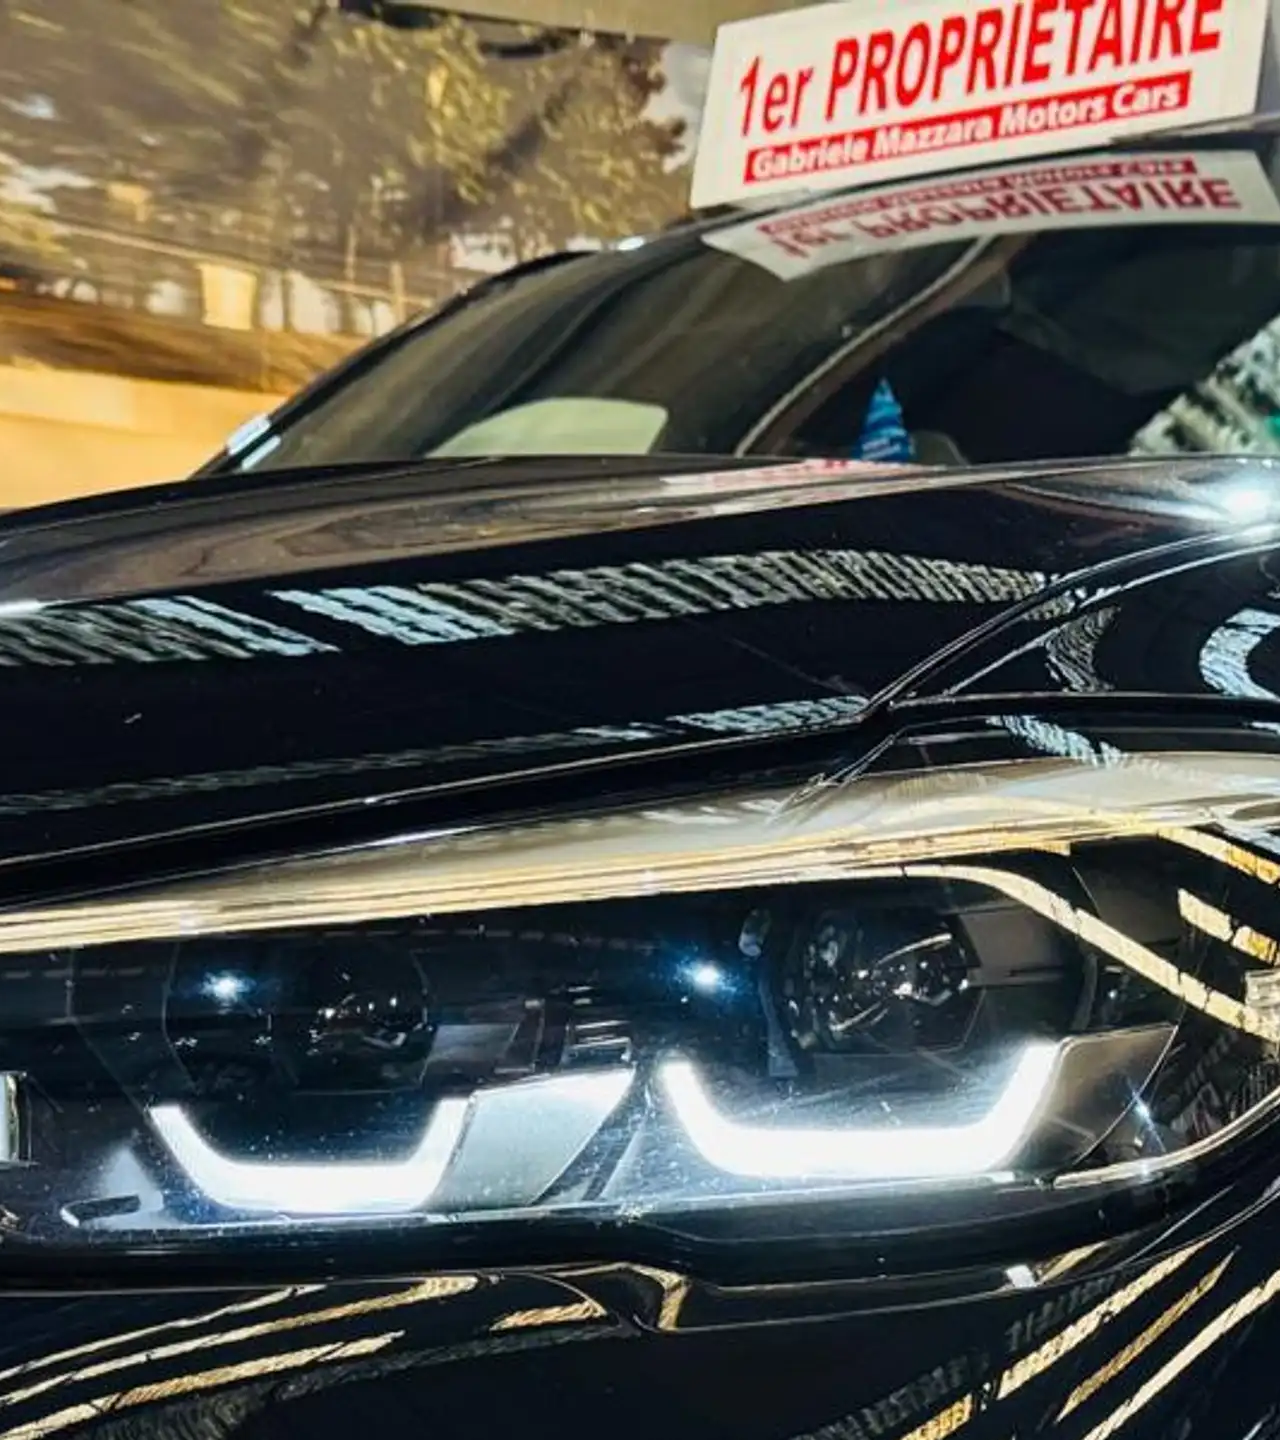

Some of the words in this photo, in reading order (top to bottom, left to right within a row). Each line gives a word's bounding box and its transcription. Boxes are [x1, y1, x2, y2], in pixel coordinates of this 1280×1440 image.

[740, 56, 812, 137] 1er
[825, 0, 1223, 122] PROPRIETAIRE
[752, 139, 865, 182] Gabriele
[872, 115, 993, 157] Mazzara
[999, 98, 1107, 139] Motors
[1113, 81, 1181, 119] Cars
